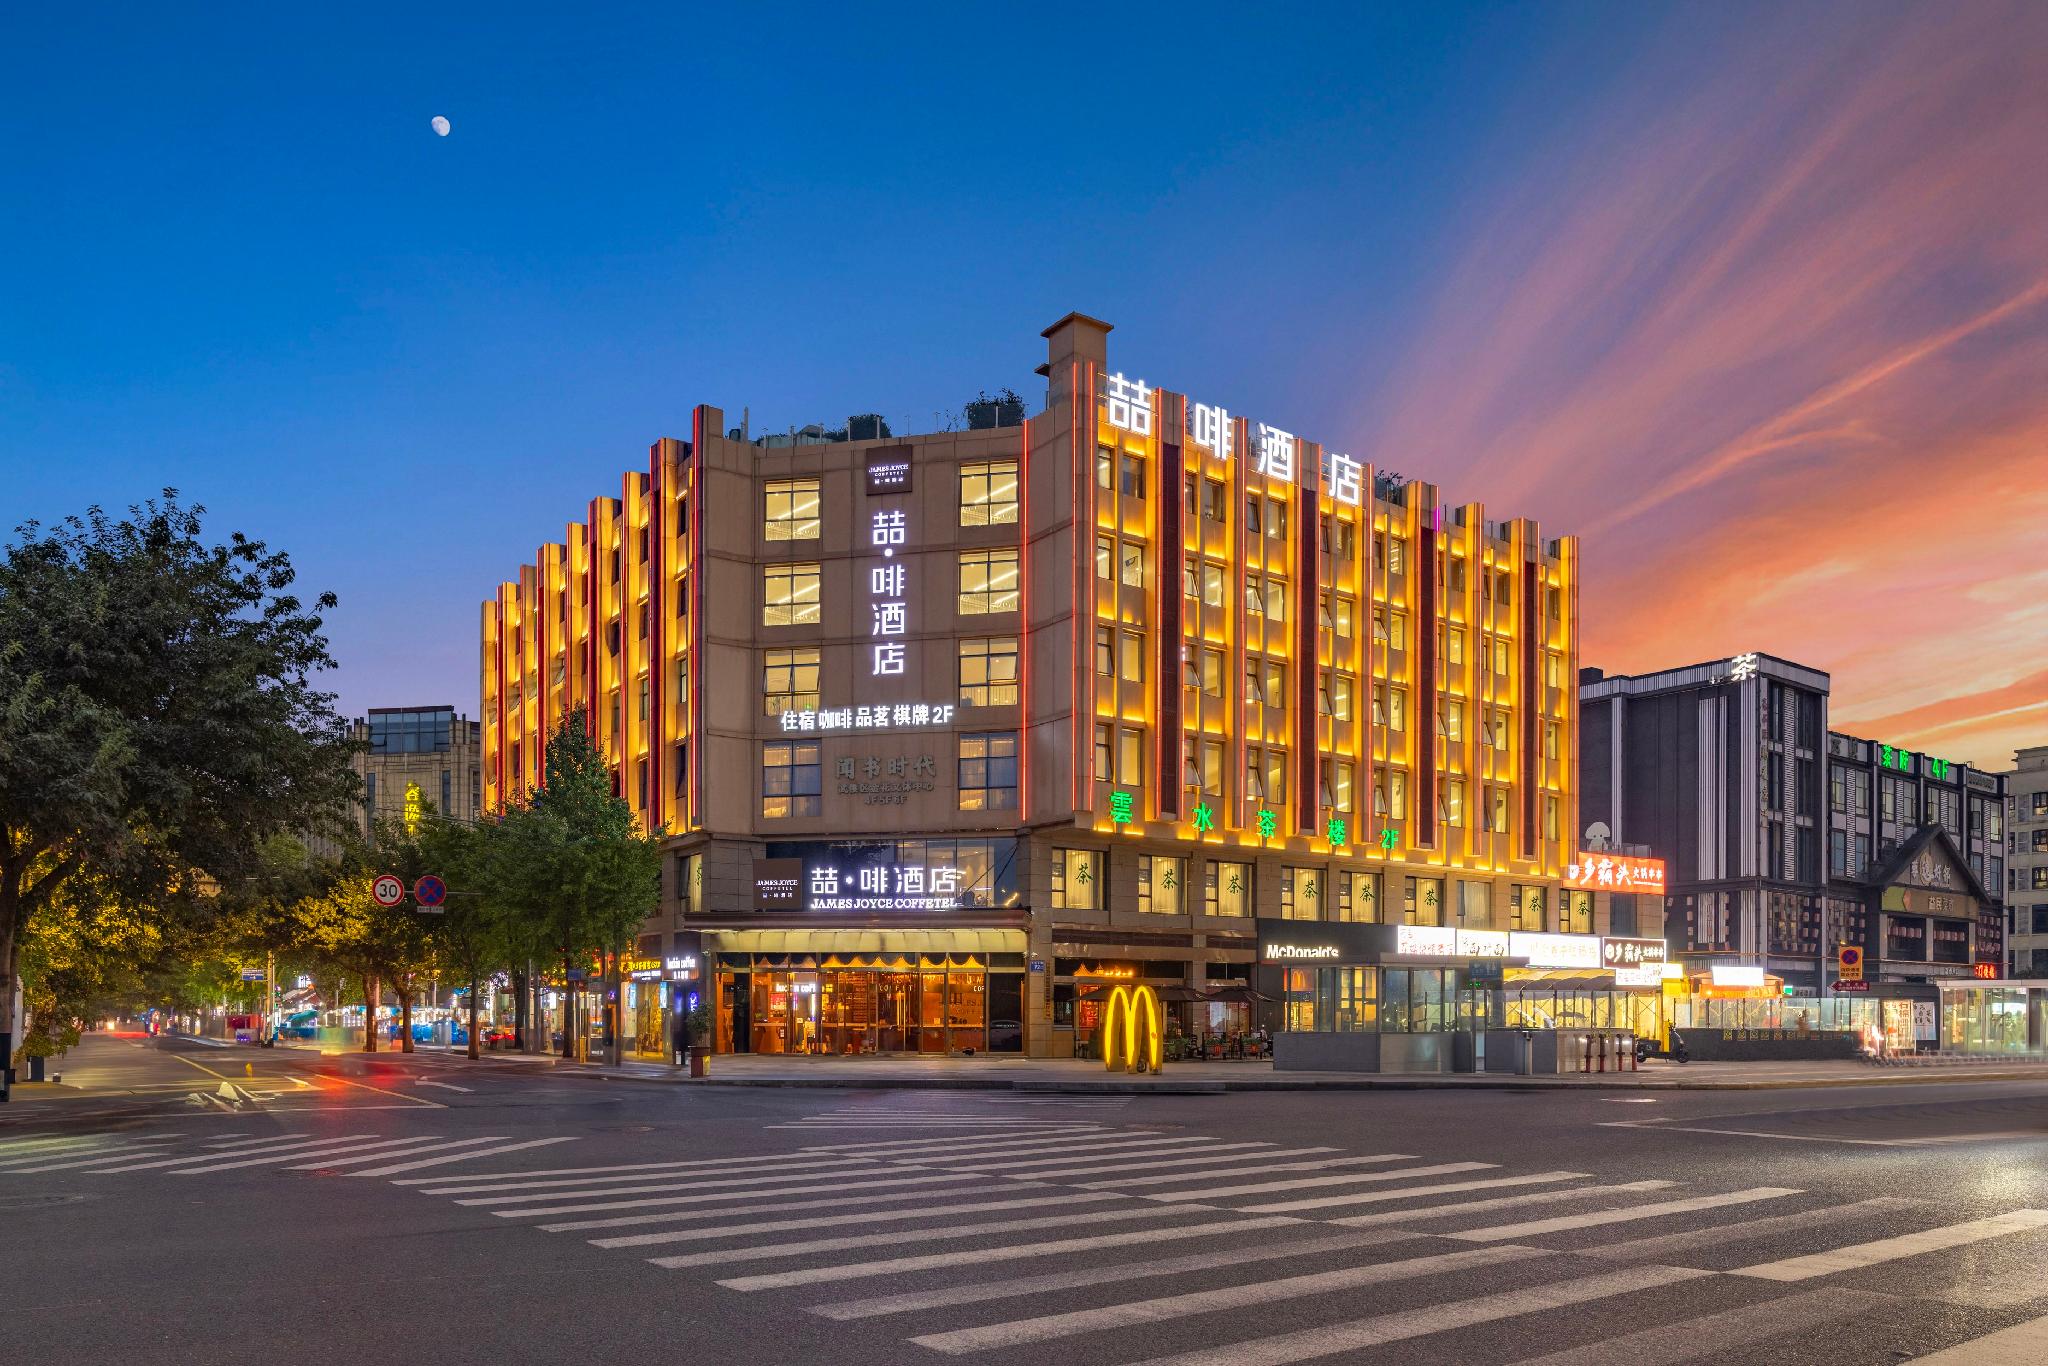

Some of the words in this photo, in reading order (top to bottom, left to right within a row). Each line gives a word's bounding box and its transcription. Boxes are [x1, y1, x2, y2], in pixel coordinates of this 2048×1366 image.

[1107, 371, 1362, 506] 喆啡酒店
[1731, 653, 1757, 681] 茶
[380, 884, 398, 898] 30
[811, 898, 852, 909] JAMES
[854, 898, 893, 909] JOYCE
[895, 898, 958, 908] COFFETEL
[1266, 944, 1339, 959] McDonald's
